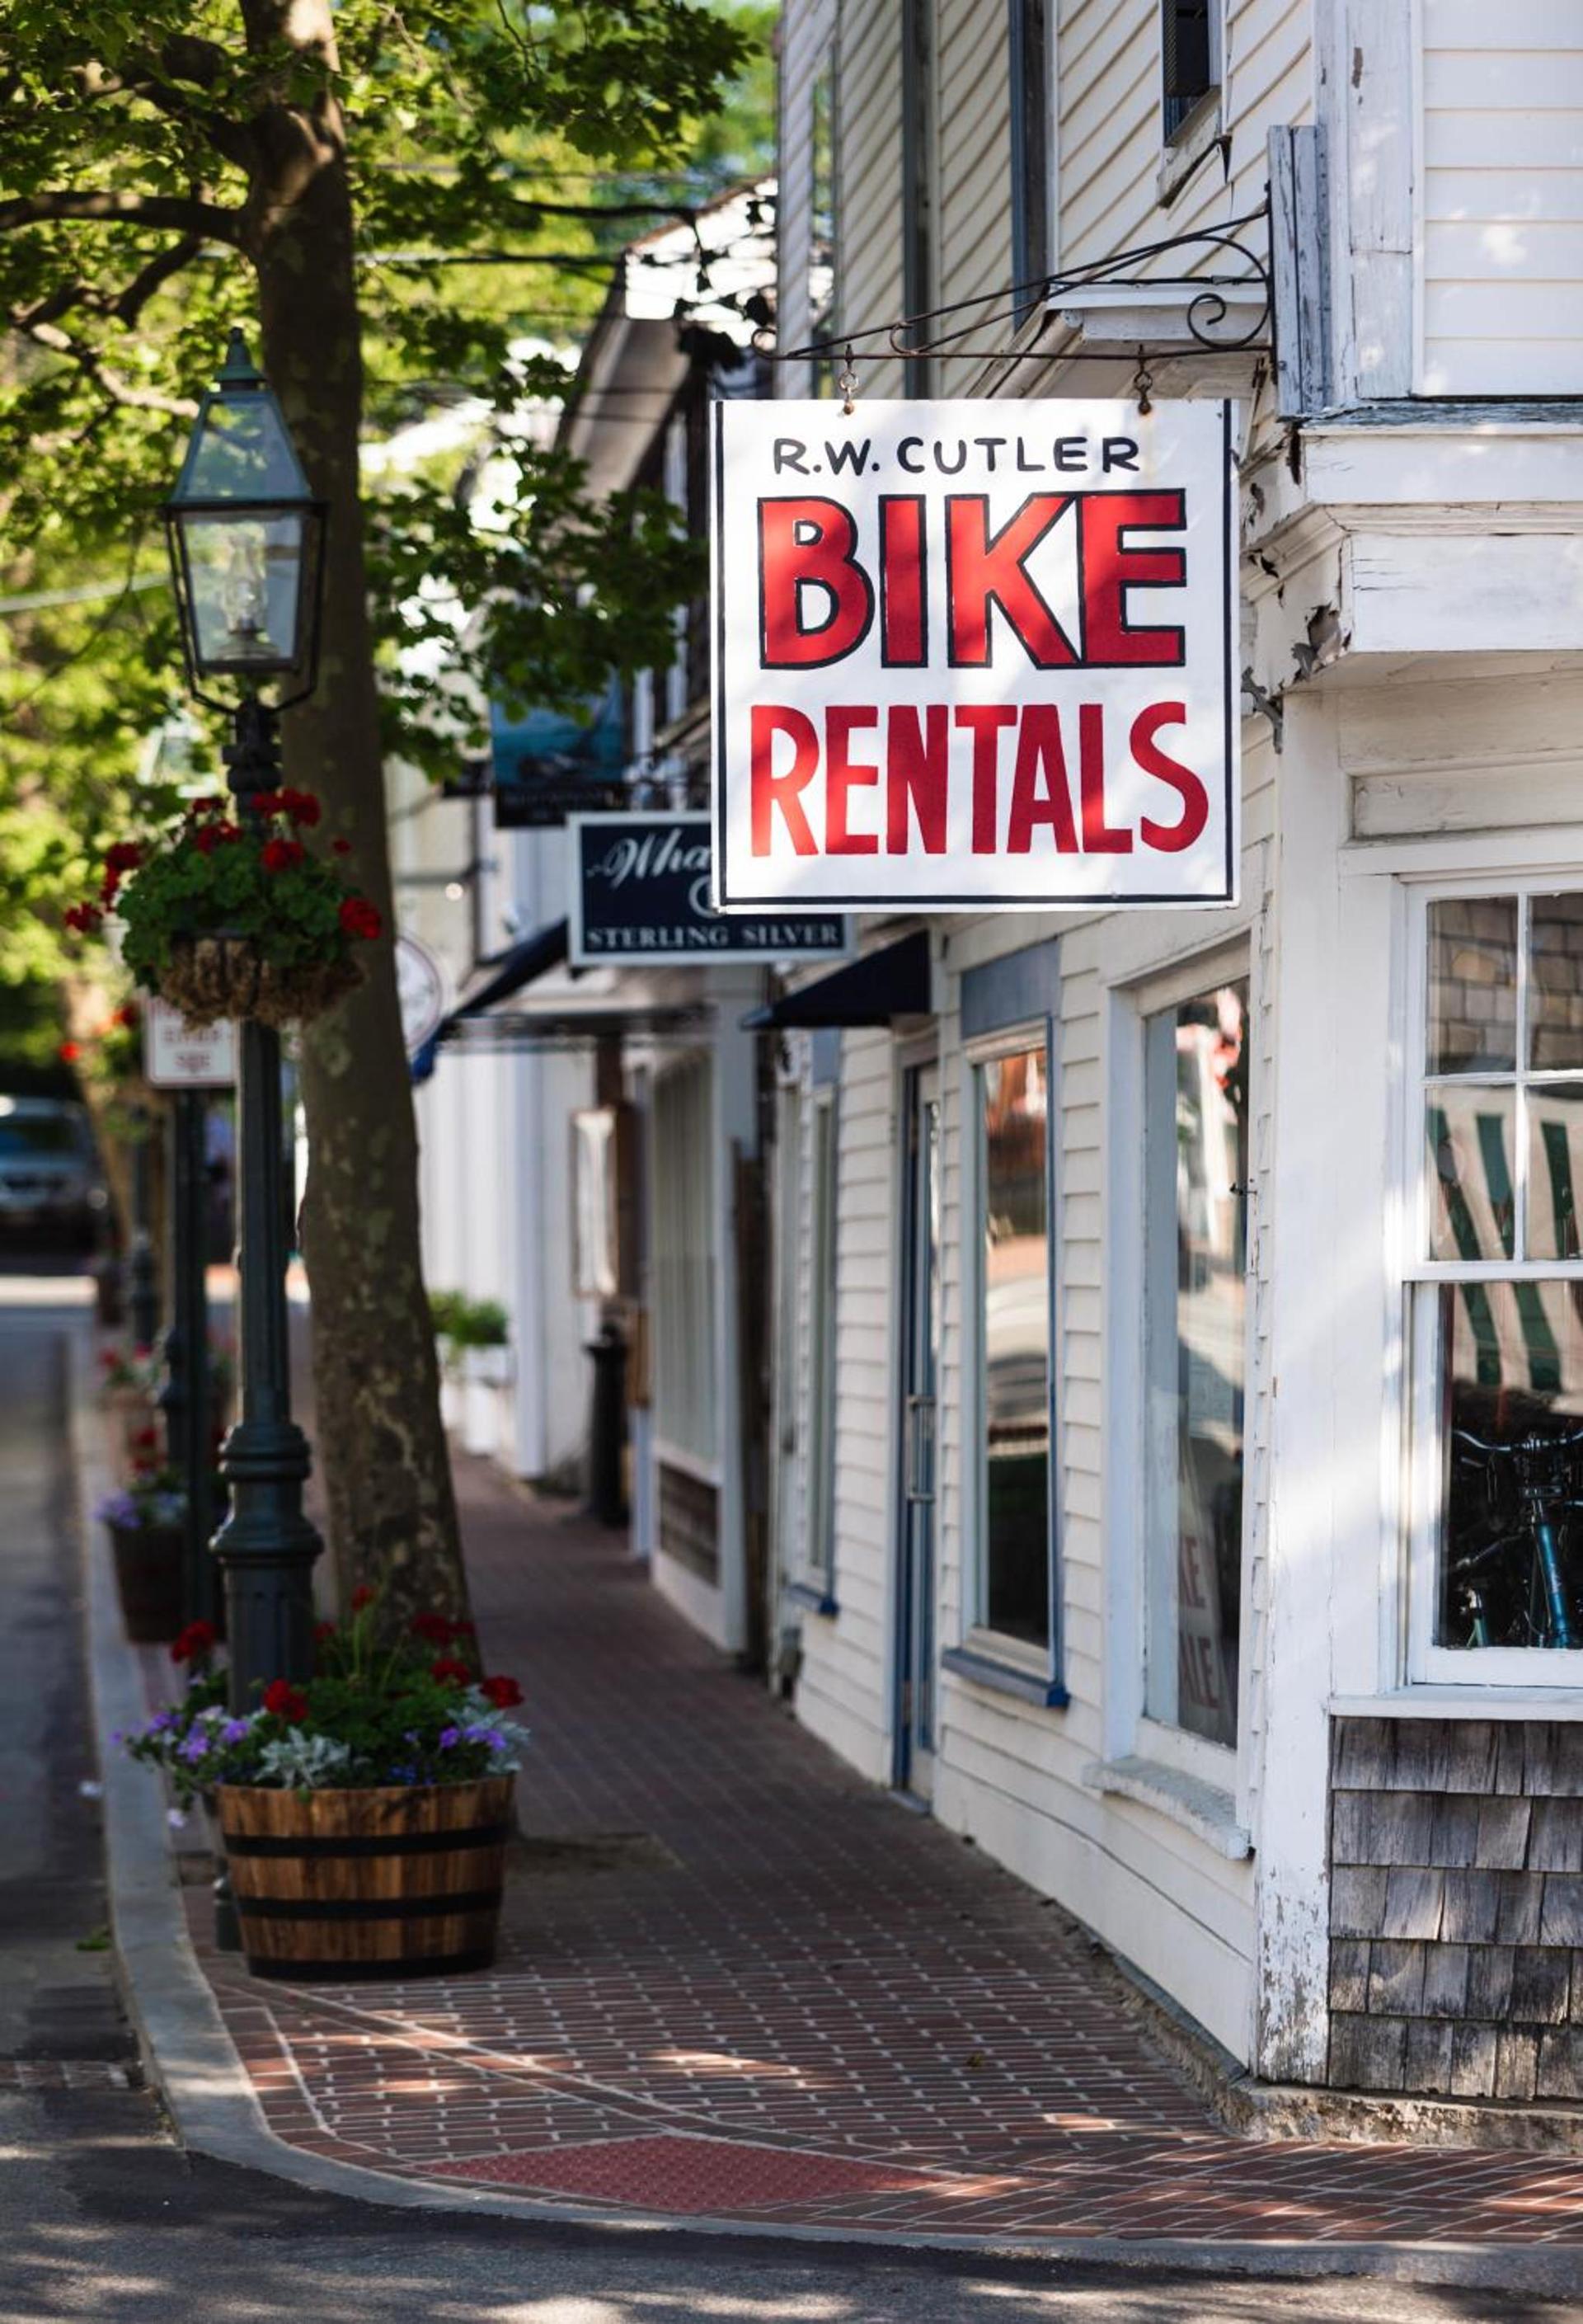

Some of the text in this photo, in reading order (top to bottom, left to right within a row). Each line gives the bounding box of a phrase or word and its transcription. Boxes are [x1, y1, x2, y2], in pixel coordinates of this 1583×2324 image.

[773, 436, 1140, 476] R.W. CUTLER
[757, 488, 1187, 670] BIKE
[750, 701, 1210, 856] RENTALS
[585, 827, 712, 889] Wha
[586, 923, 839, 948] STERLING SILVER
